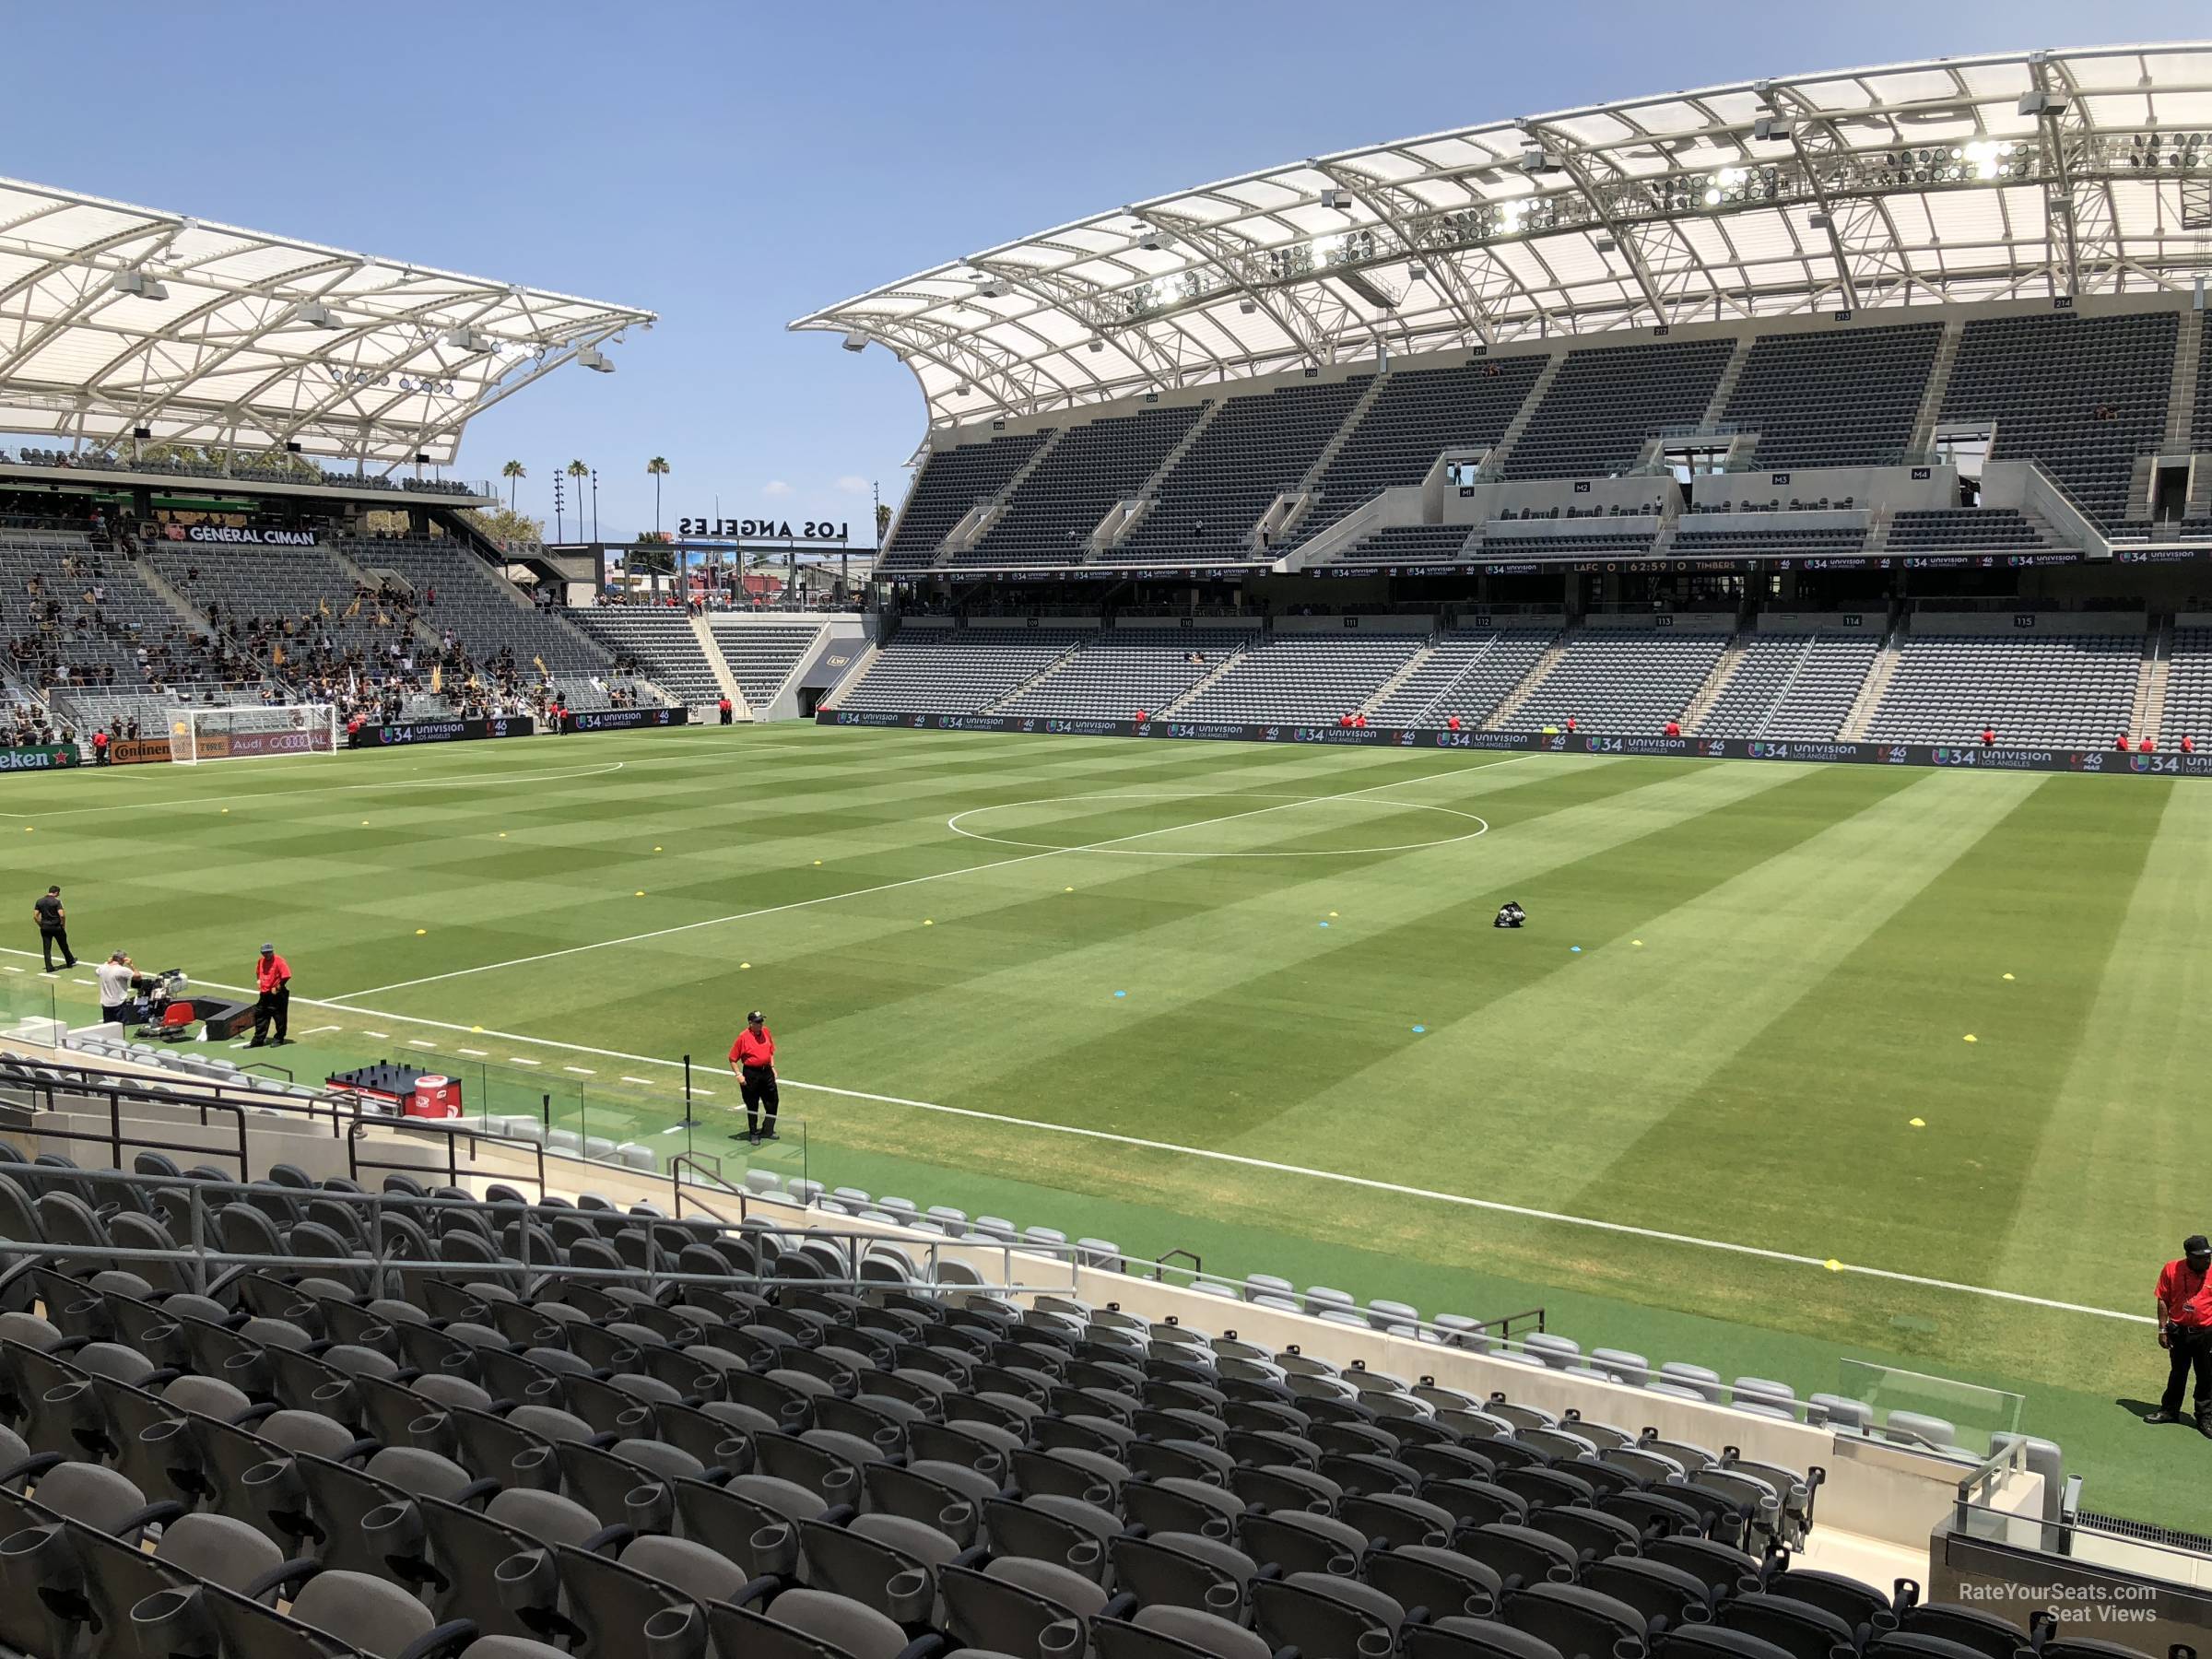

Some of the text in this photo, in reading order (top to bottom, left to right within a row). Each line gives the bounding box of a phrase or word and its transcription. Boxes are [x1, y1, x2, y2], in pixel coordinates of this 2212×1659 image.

[190, 525, 315, 546] GÉNÉRAL CIMAN
[2018, 556, 2033, 565] 34
[2131, 553, 2147, 562] 34
[1574, 561, 1735, 571] LAFC 0 62:59 0 TIMBERS
[1814, 559, 1828, 569] 34
[1913, 558, 1928, 568] 34
[1212, 569, 1222, 577] 34
[1338, 569, 1349, 577] 34
[659, 710, 669, 720] 46
[846, 712, 859, 724] 34
[494, 720, 507, 730] 46
[586, 715, 601, 728] 34
[948, 717, 962, 728] 34
[1024, 719, 1034, 727] 46
[1056, 721, 1072, 733] 34
[1139, 724, 1150, 732] 46
[1178, 724, 1195, 737] 34
[1266, 727, 1279, 735] 46
[394, 727, 413, 742] 34
[1306, 729, 1324, 741] 34
[1402, 731, 1416, 740] 46
[233, 739, 262, 750] Audi
[1451, 734, 1471, 747] 34
[1551, 735, 1566, 745] 46
[1601, 738, 1623, 751] 34
[1709, 740, 1725, 750] 46
[1764, 744, 1788, 758] 34
[1889, 747, 1907, 757] 46
[1950, 750, 1976, 764] 34
[2083, 753, 2103, 764] 46
[2150, 757, 2180, 771] 34
